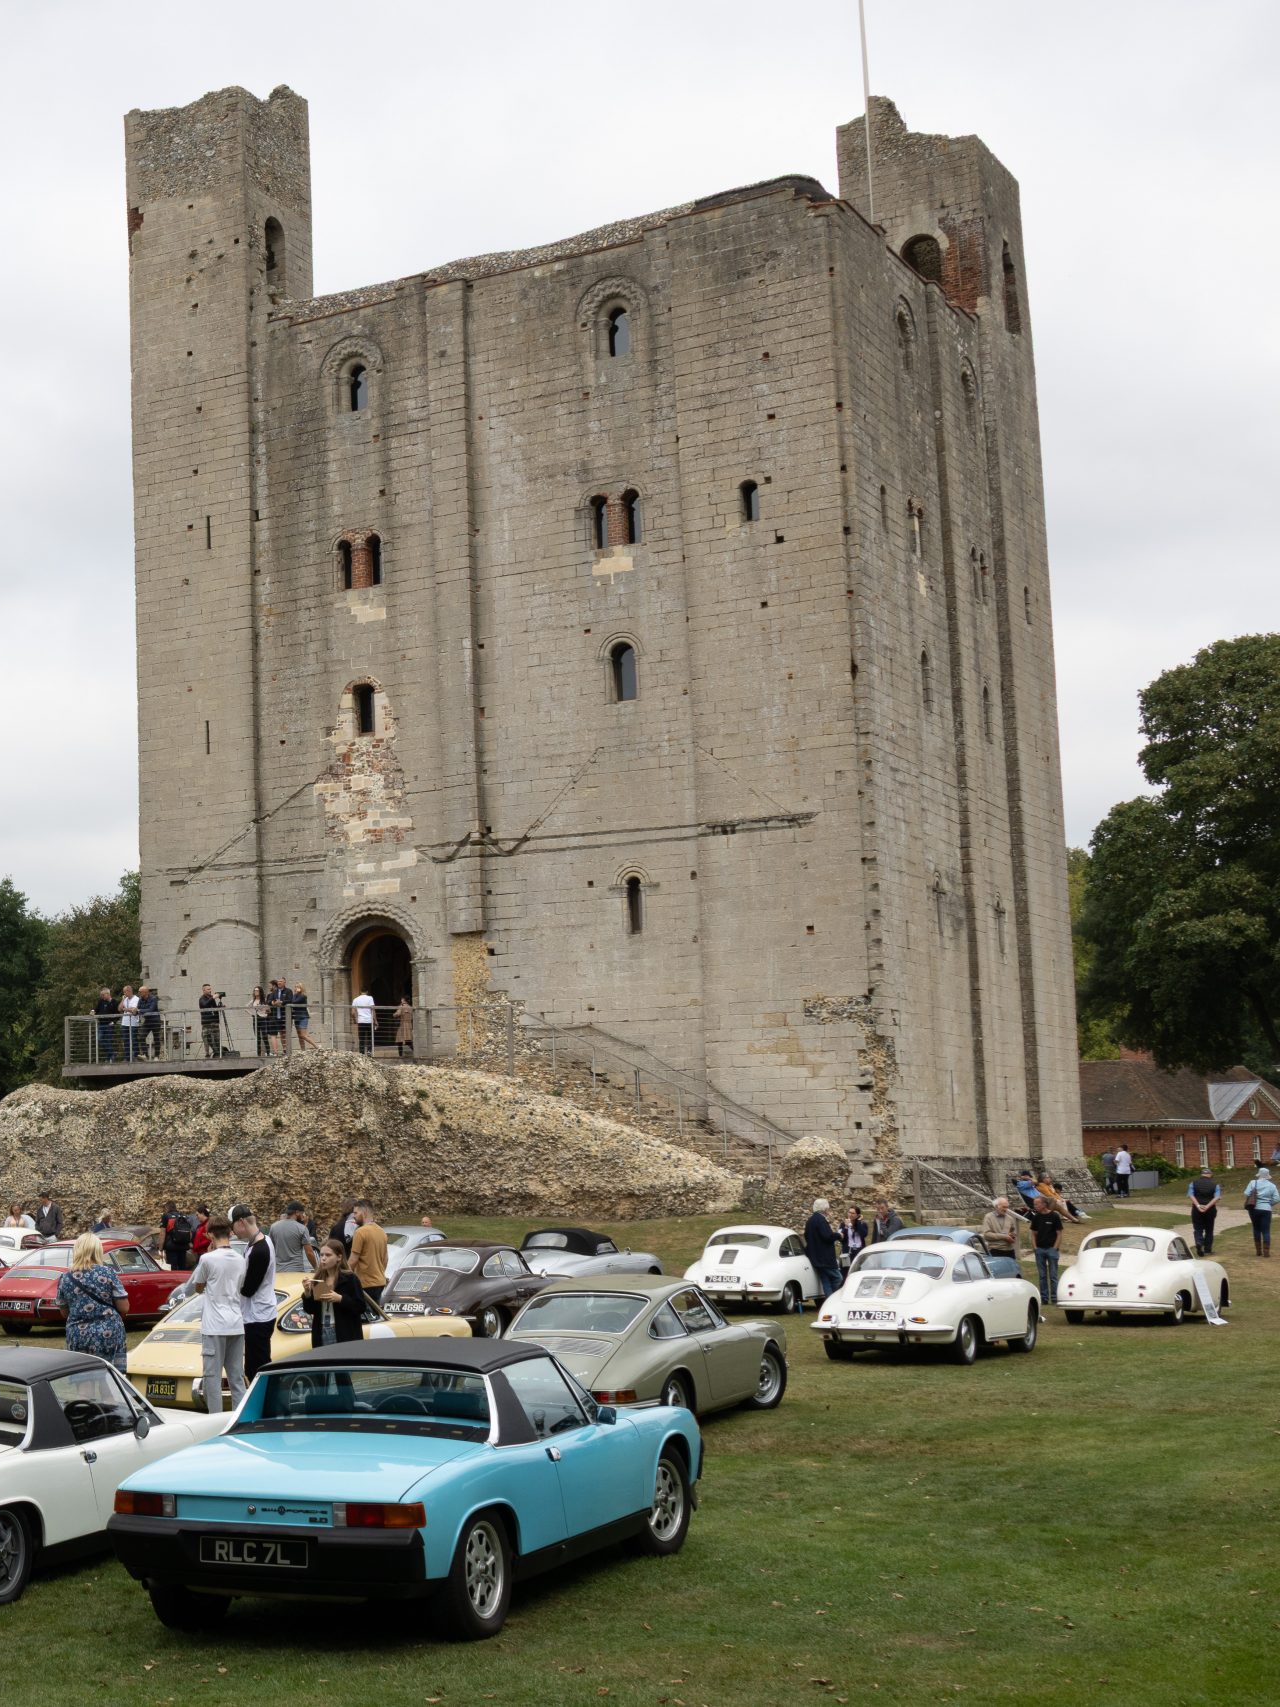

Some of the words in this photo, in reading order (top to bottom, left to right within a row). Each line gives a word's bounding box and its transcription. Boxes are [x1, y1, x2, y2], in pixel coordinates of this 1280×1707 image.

[848, 1311, 867, 1320] AAX
[869, 1312, 895, 1320] 785A
[148, 1384, 159, 1393] YTA
[215, 1540, 257, 1562] RLC
[262, 1543, 290, 1564] 7L
